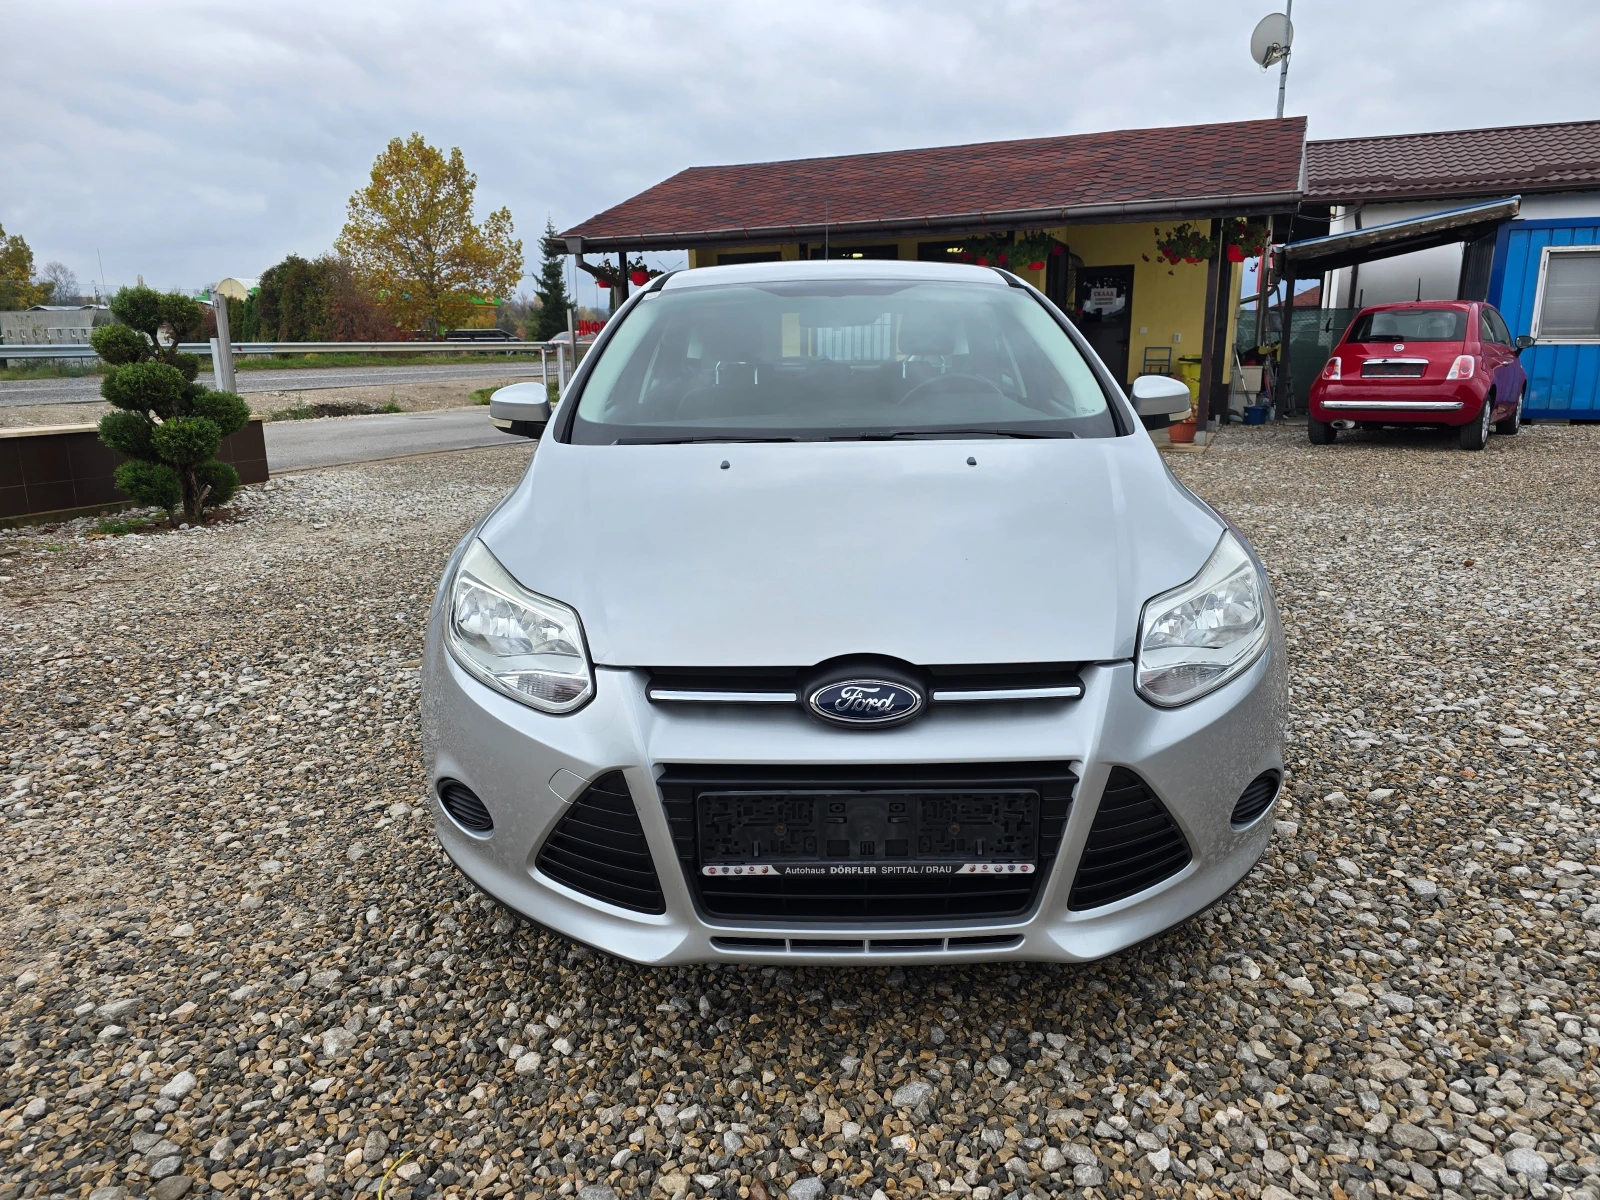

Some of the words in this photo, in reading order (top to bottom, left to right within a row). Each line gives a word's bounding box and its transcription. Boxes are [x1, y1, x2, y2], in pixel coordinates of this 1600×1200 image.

[834, 686, 896, 711] Ford
[785, 866, 826, 875] Autohaus
[830, 864, 877, 875] DÖRFLER
